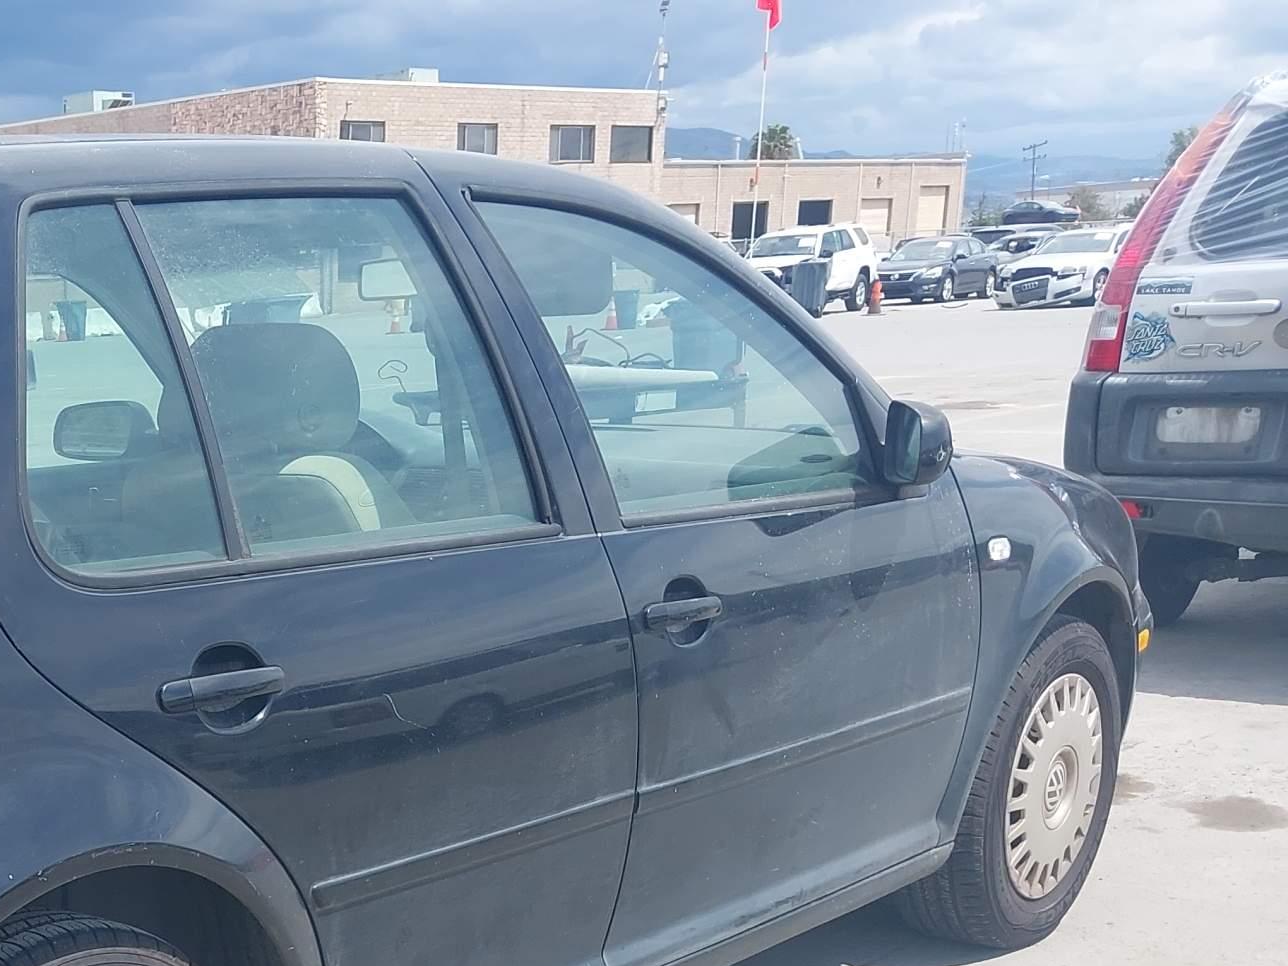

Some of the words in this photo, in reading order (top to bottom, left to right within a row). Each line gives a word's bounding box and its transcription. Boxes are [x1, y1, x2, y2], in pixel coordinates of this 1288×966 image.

[1127, 319, 1169, 340] SANTA
[1130, 336, 1165, 358] CRUZ
[1176, 340, 1262, 358] CR-V
